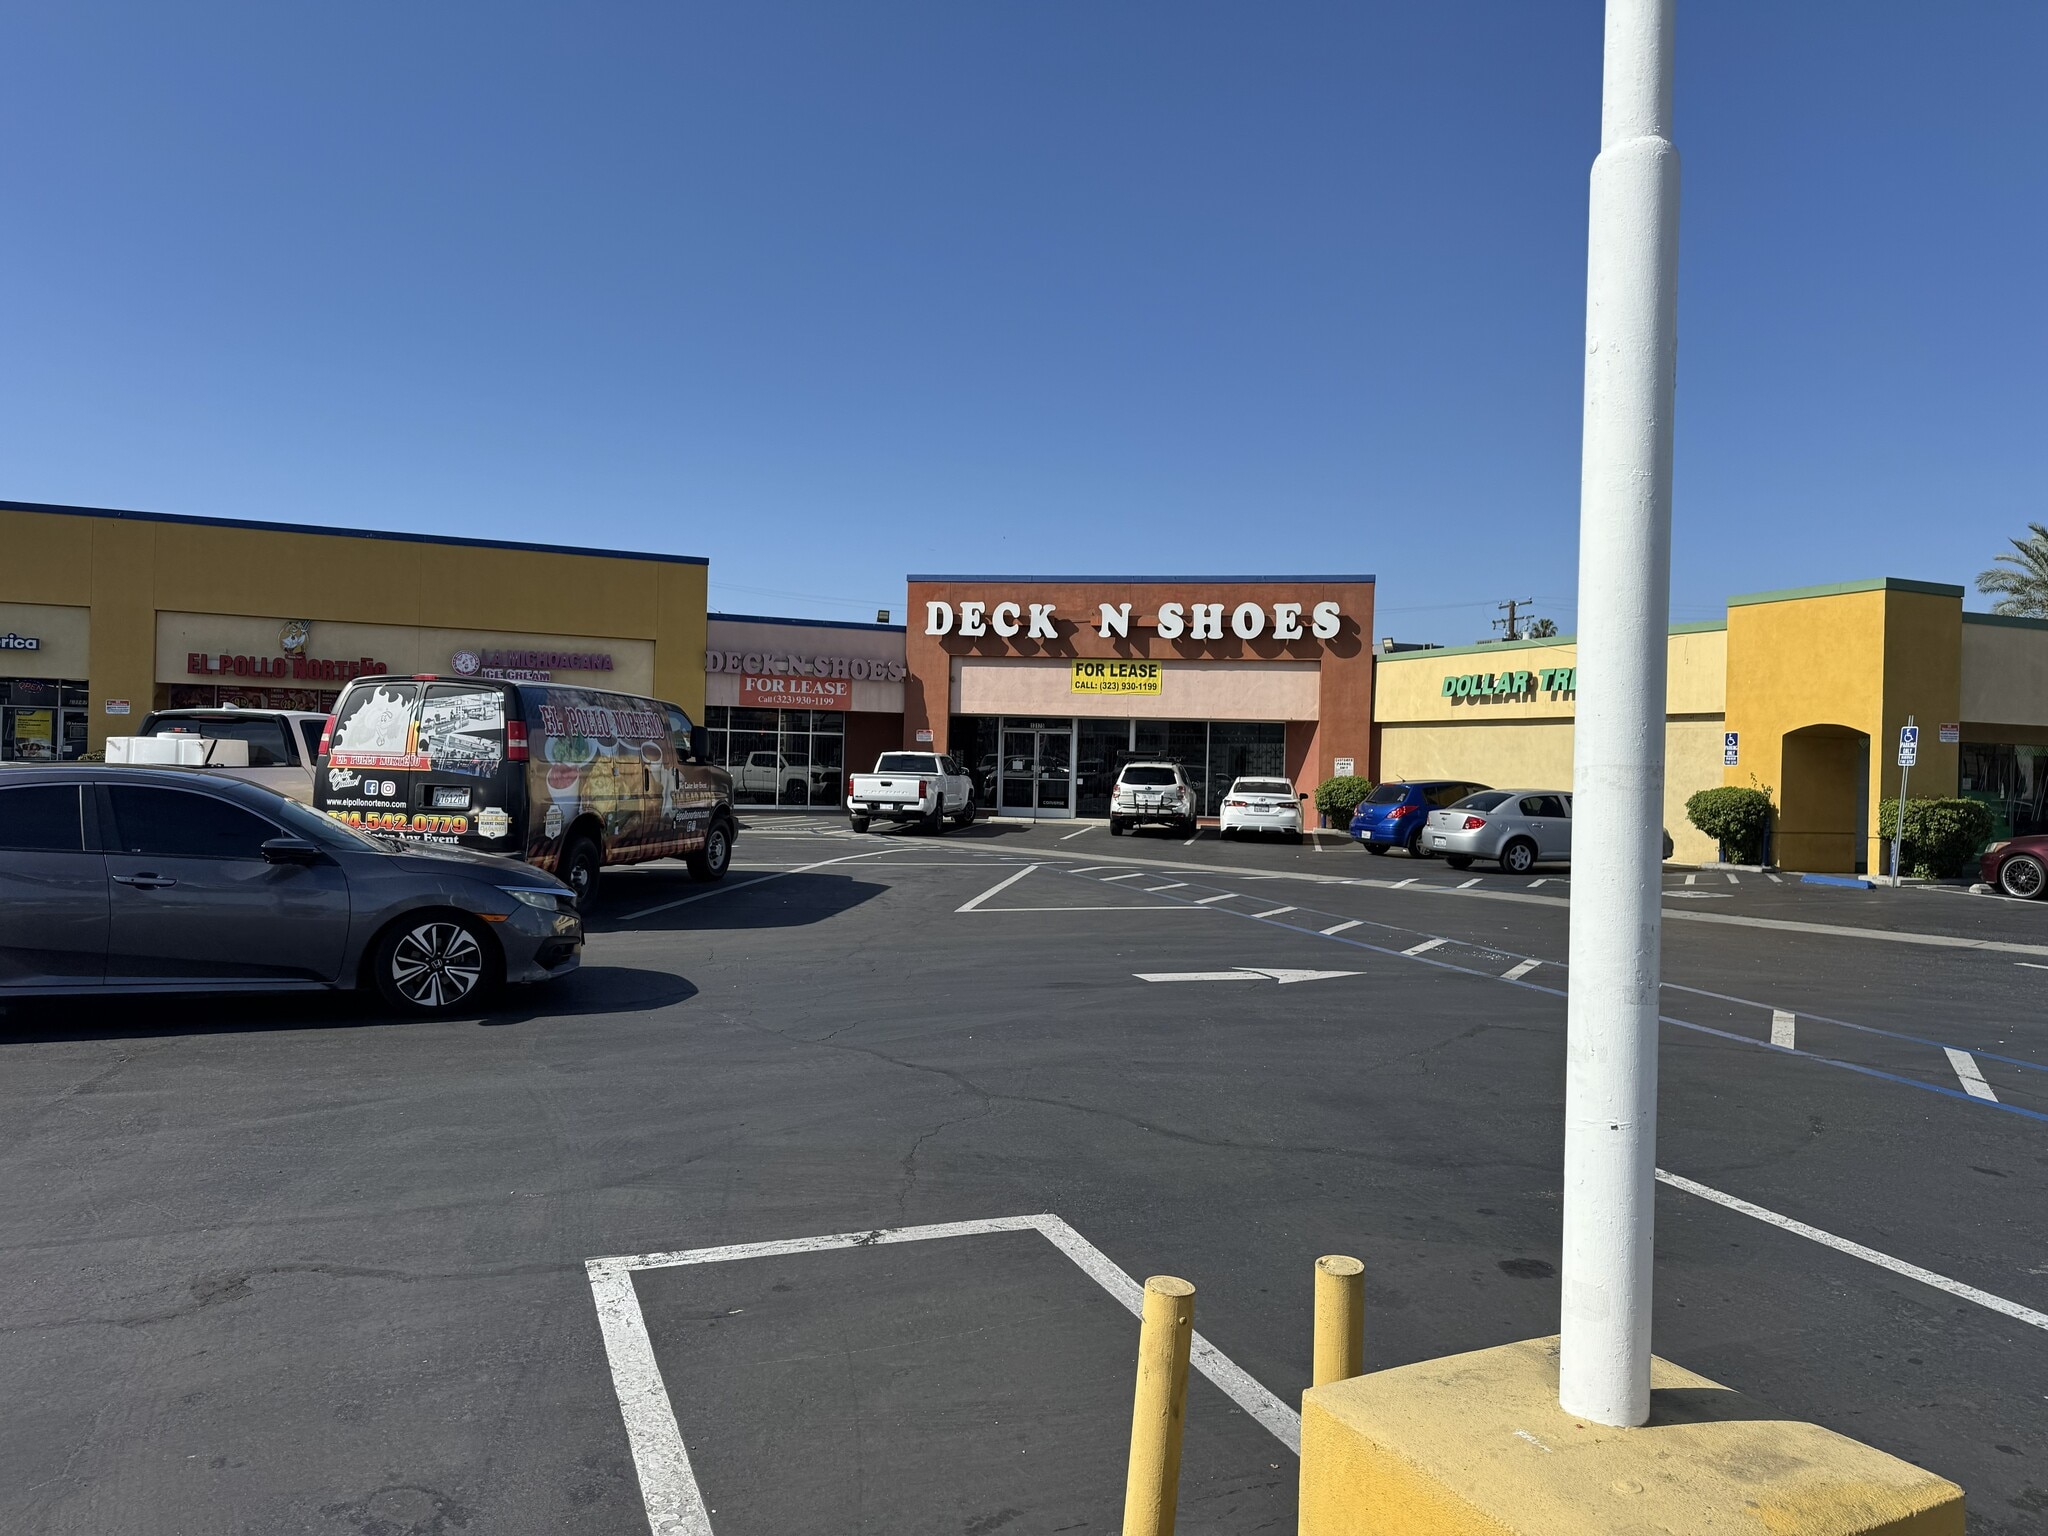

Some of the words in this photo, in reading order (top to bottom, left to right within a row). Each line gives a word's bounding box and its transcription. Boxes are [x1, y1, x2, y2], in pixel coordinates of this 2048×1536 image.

[924, 601, 1059, 639] DECK
[1098, 603, 1132, 638] N
[1157, 601, 1341, 640] SHOES
[0, 634, 37, 649] rica
[187, 652, 213, 675] EL
[218, 654, 287, 679] POLLO
[481, 649, 500, 667] LA
[508, 650, 614, 671] MICHOACANA
[704, 650, 779, 676] DECK
[786, 654, 807, 676] N
[811, 655, 904, 683] SHOES
[481, 668, 503, 679] ICE
[505, 668, 550, 682] CREAM
[1075, 662, 1105, 677] FOR
[1110, 663, 1157, 678] LEASE
[744, 677, 785, 692] FOR
[789, 681, 847, 696] LEASE
[1074, 681, 1098, 689] CALL:
[1099, 682, 1120, 691] (323)
[1121, 682, 1158, 691] 930-1199
[1441, 671, 1529, 697] DOLLAR
[758, 695, 773, 703] Call
[773, 695, 795, 705] (323)
[796, 696, 834, 706] 930-1199
[539, 704, 566, 737] EL
[565, 706, 613, 738] POLLO
[326, 798, 407, 808] www.elpollonorteno.com
[423, 832, 459, 845] Event
